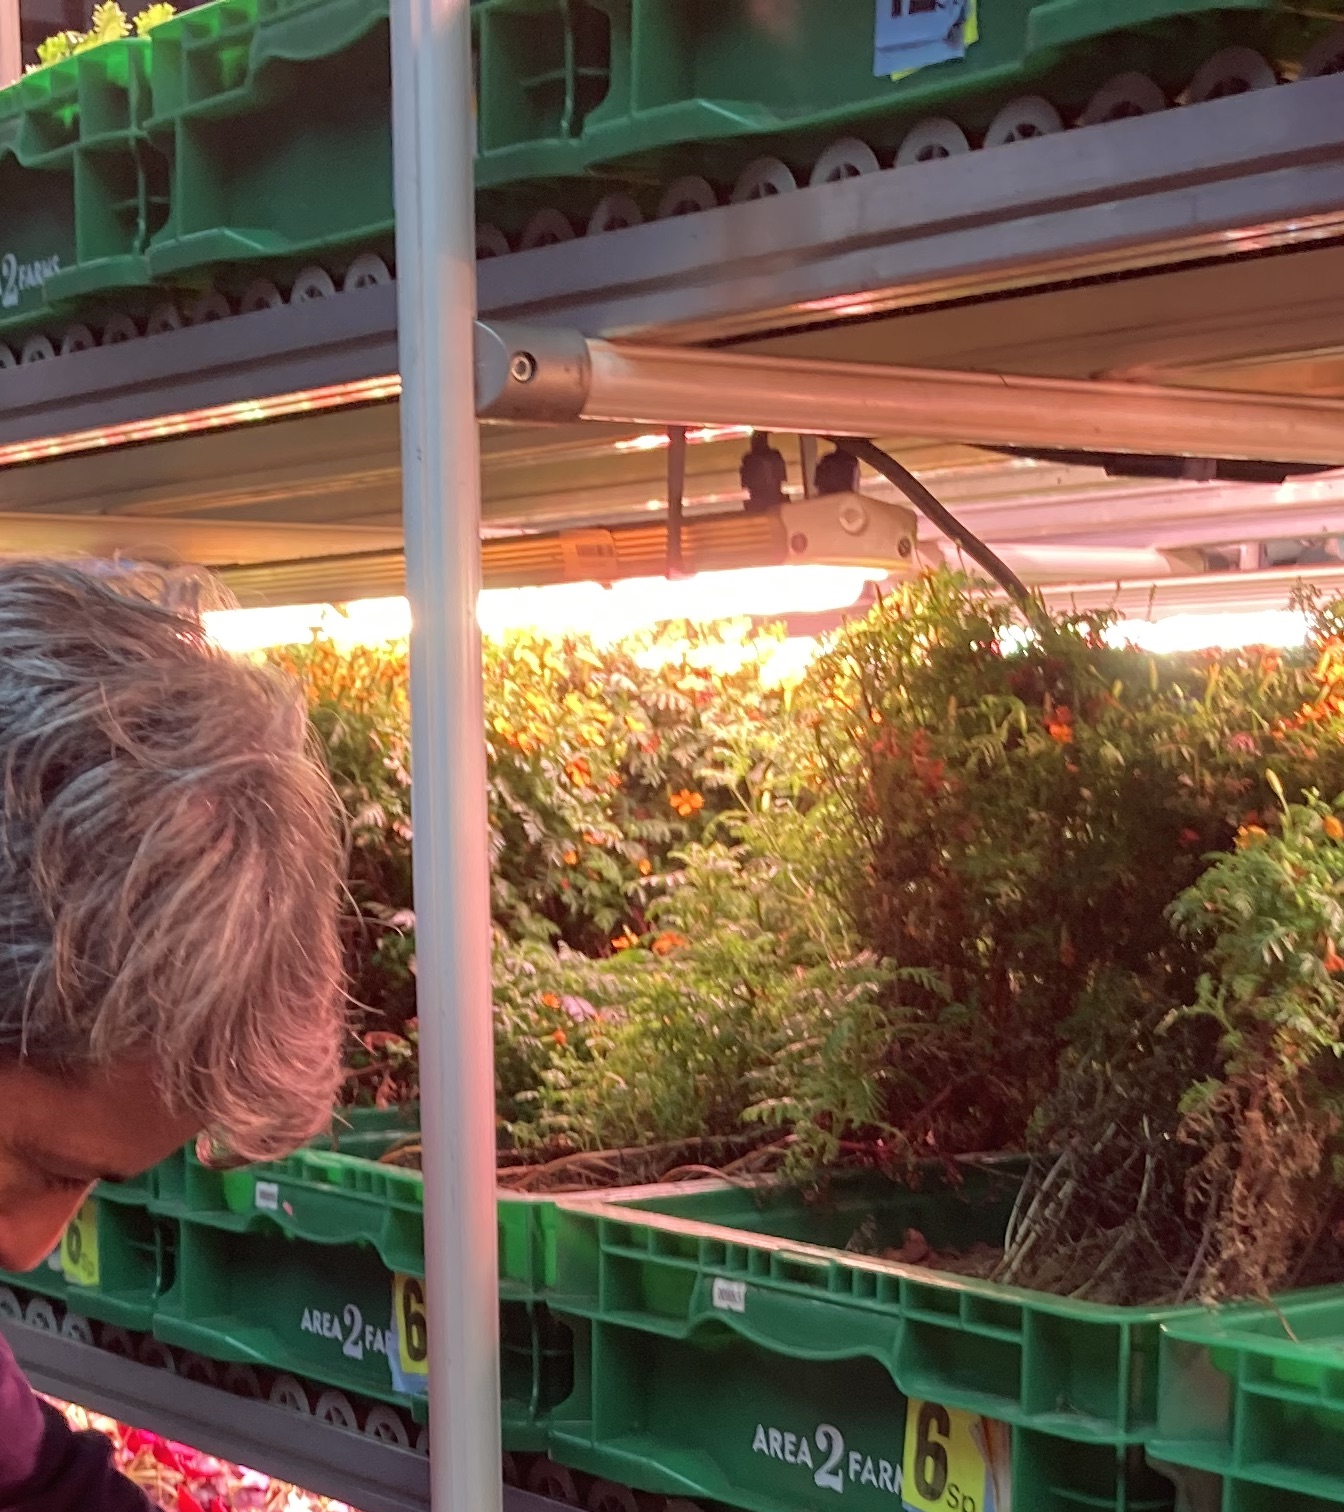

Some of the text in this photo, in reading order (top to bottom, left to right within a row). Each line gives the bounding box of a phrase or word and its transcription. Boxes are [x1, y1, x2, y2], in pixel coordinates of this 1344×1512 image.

[1, 252, 19, 308] 2
[300, 1306, 343, 1342] AREA
[342, 1303, 363, 1360] 2
[403, 1277, 428, 1362] 6
[752, 1422, 904, 1496] AREA 2 FAR
[914, 1401, 951, 1501] 6
